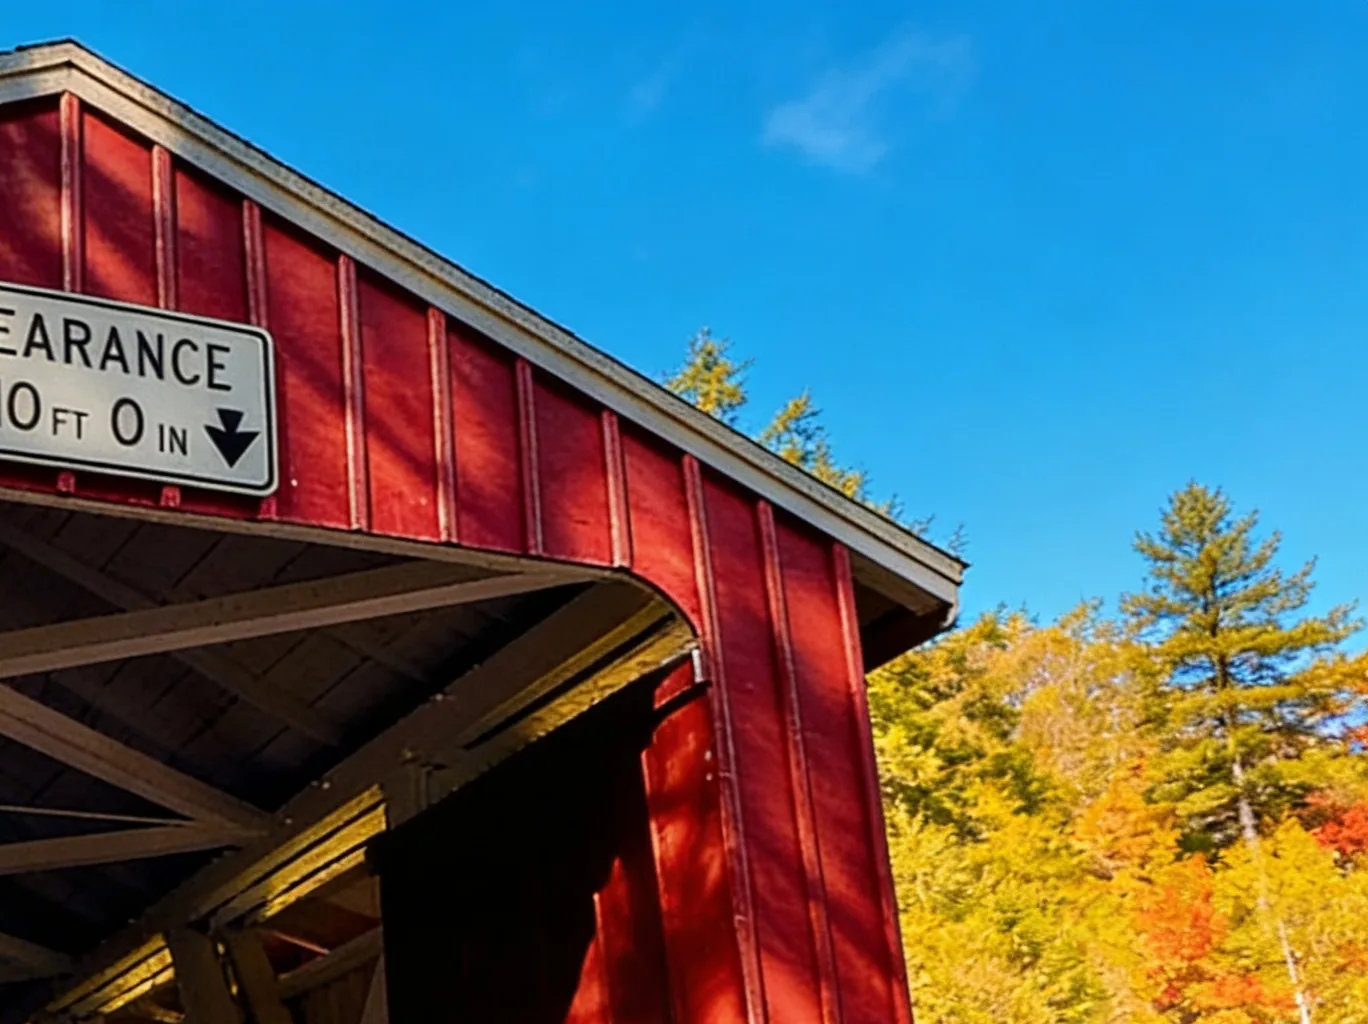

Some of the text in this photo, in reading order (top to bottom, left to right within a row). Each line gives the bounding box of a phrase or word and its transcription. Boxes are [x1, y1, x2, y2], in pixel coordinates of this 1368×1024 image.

[51, 407, 89, 440] FT
[110, 397, 145, 447] 0
[158, 423, 188, 457] IN
